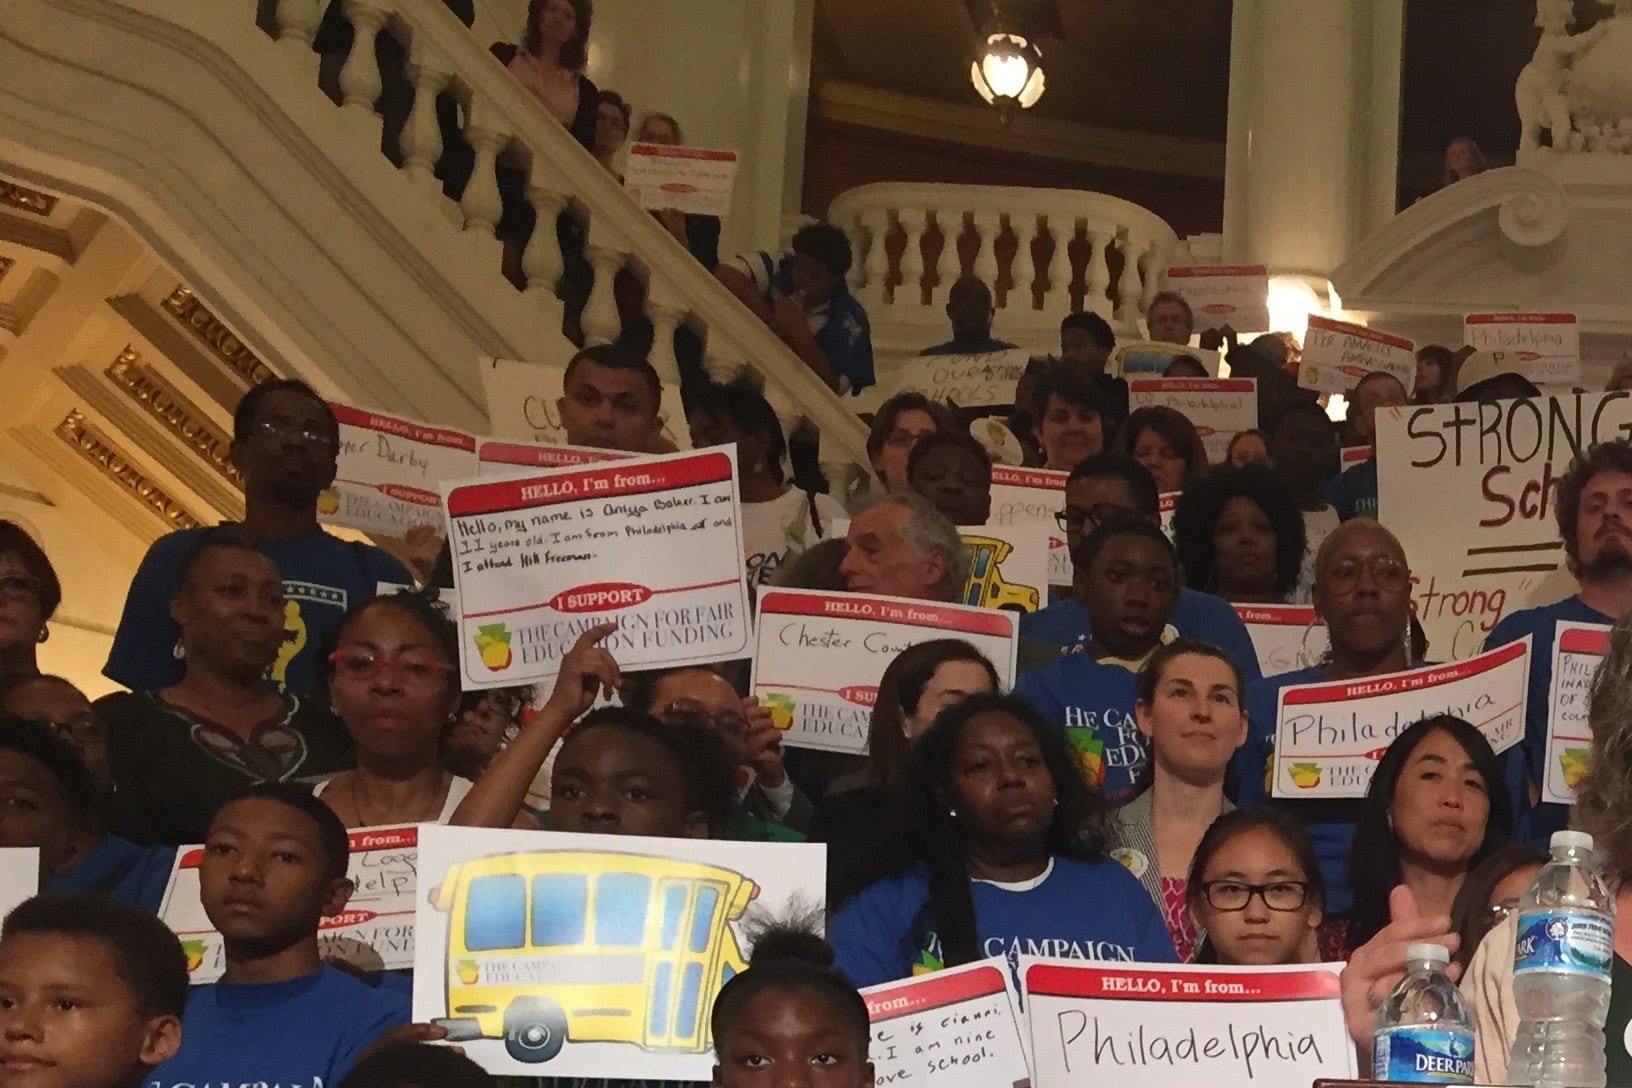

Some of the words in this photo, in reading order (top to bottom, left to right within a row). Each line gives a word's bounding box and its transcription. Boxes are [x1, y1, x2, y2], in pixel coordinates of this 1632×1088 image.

[377, 434, 429, 476] Darby
[521, 483, 579, 501] HELLO,
[583, 477, 609, 491] I'm
[614, 472, 666, 488] from...
[531, 512, 571, 526] name
[567, 589, 644, 608] SUPPORT
[696, 602, 734, 623] FAIR
[824, 601, 876, 615] HELLO,
[880, 605, 904, 618] I'm
[907, 609, 951, 624] from...
[779, 623, 851, 647] Chester
[1346, 682, 1397, 696] HELLO,
[1402, 677, 1424, 688] I'm
[1102, 976, 1166, 994] HELLO,
[1171, 980, 1200, 994] I'm
[1204, 980, 1261, 994] from...
[915, 1042, 940, 1054] am
[955, 1030, 996, 1045] nine
[1058, 1010, 1323, 1079] Philadelphia
[1416, 1053, 1455, 1072] DEER
